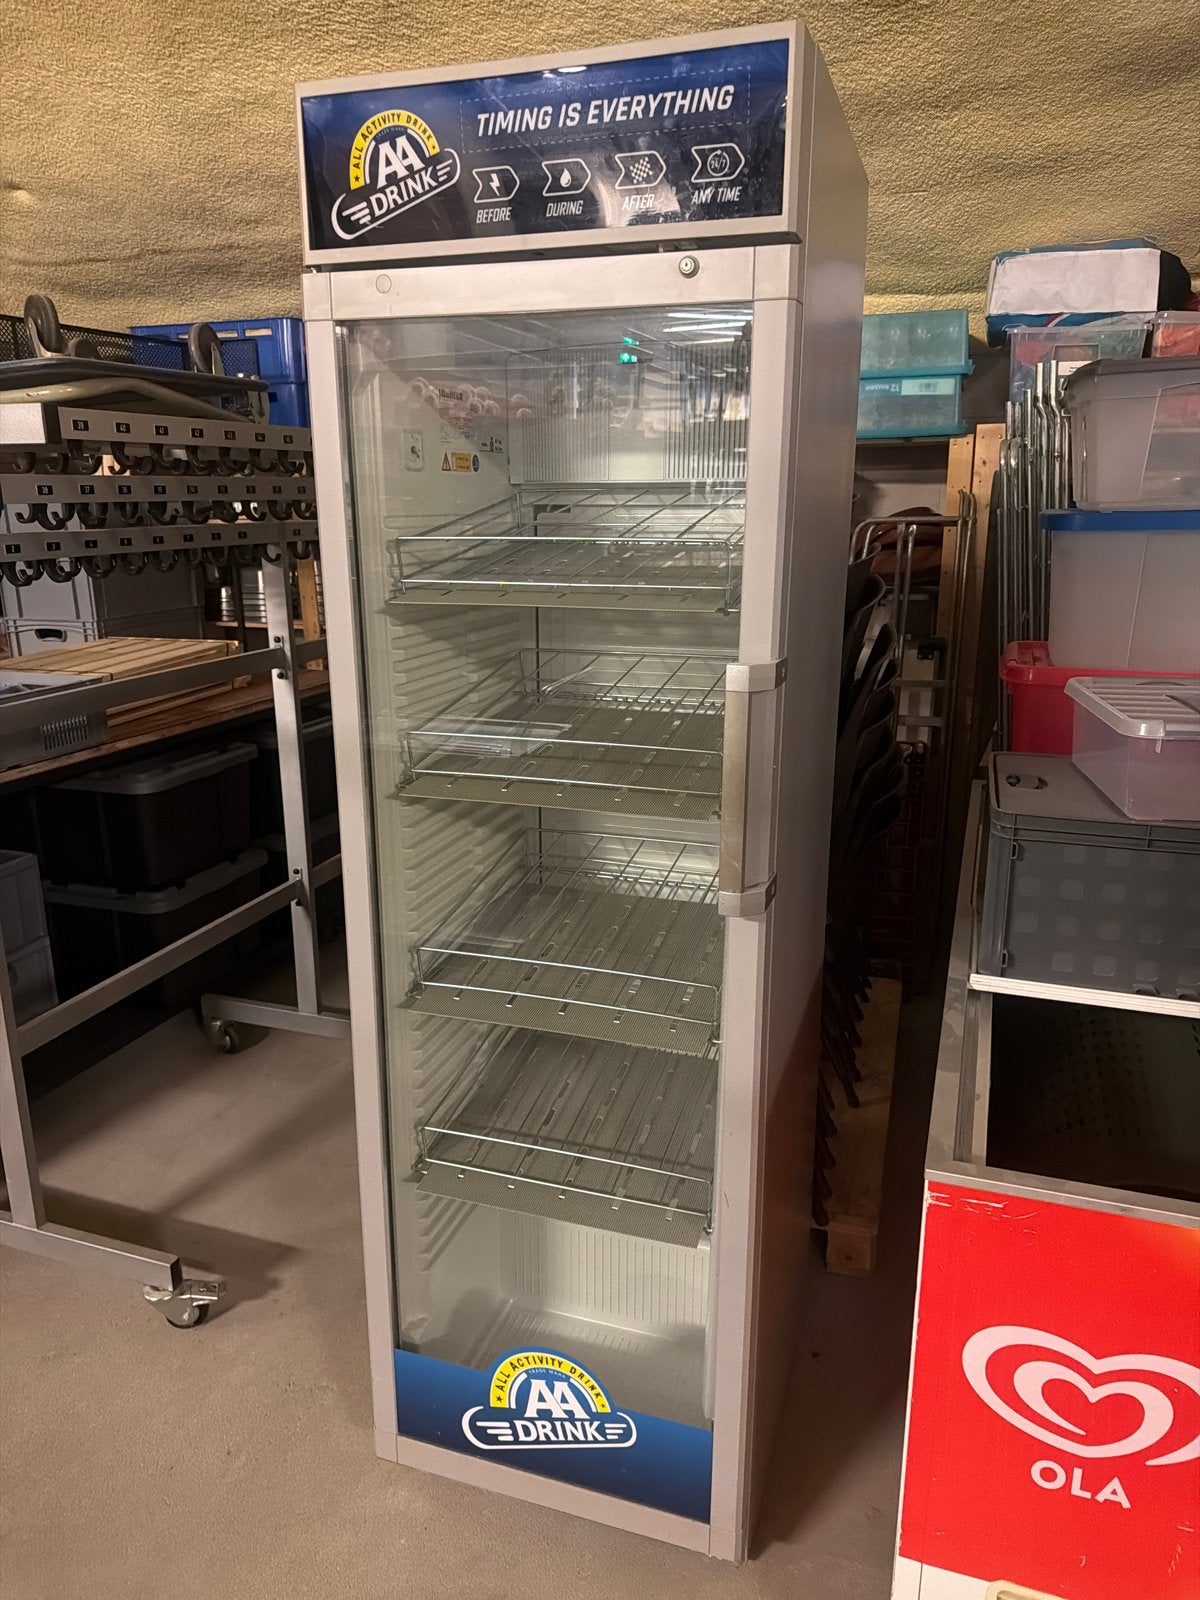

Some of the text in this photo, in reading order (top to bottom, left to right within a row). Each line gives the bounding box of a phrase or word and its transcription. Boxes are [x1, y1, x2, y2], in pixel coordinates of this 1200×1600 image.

[477, 84, 735, 137] TIMING IS EVERYTHING
[352, 112, 433, 170] ALL ACTIVITY DRINK
[376, 134, 426, 189] AA
[710, 156, 726, 170] 24/7
[369, 165, 439, 217] DRINK
[545, 200, 584, 217] DURING
[622, 193, 655, 211] AFTER
[690, 185, 743, 205] ANY TIME
[476, 206, 512, 224] BEFORE
[495, 1355, 603, 1399] ALL ACTIVITY DRINK
[523, 1379, 591, 1419] AA
[513, 1420, 606, 1442] DRINK
[1030, 1459, 1132, 1509] OLA
